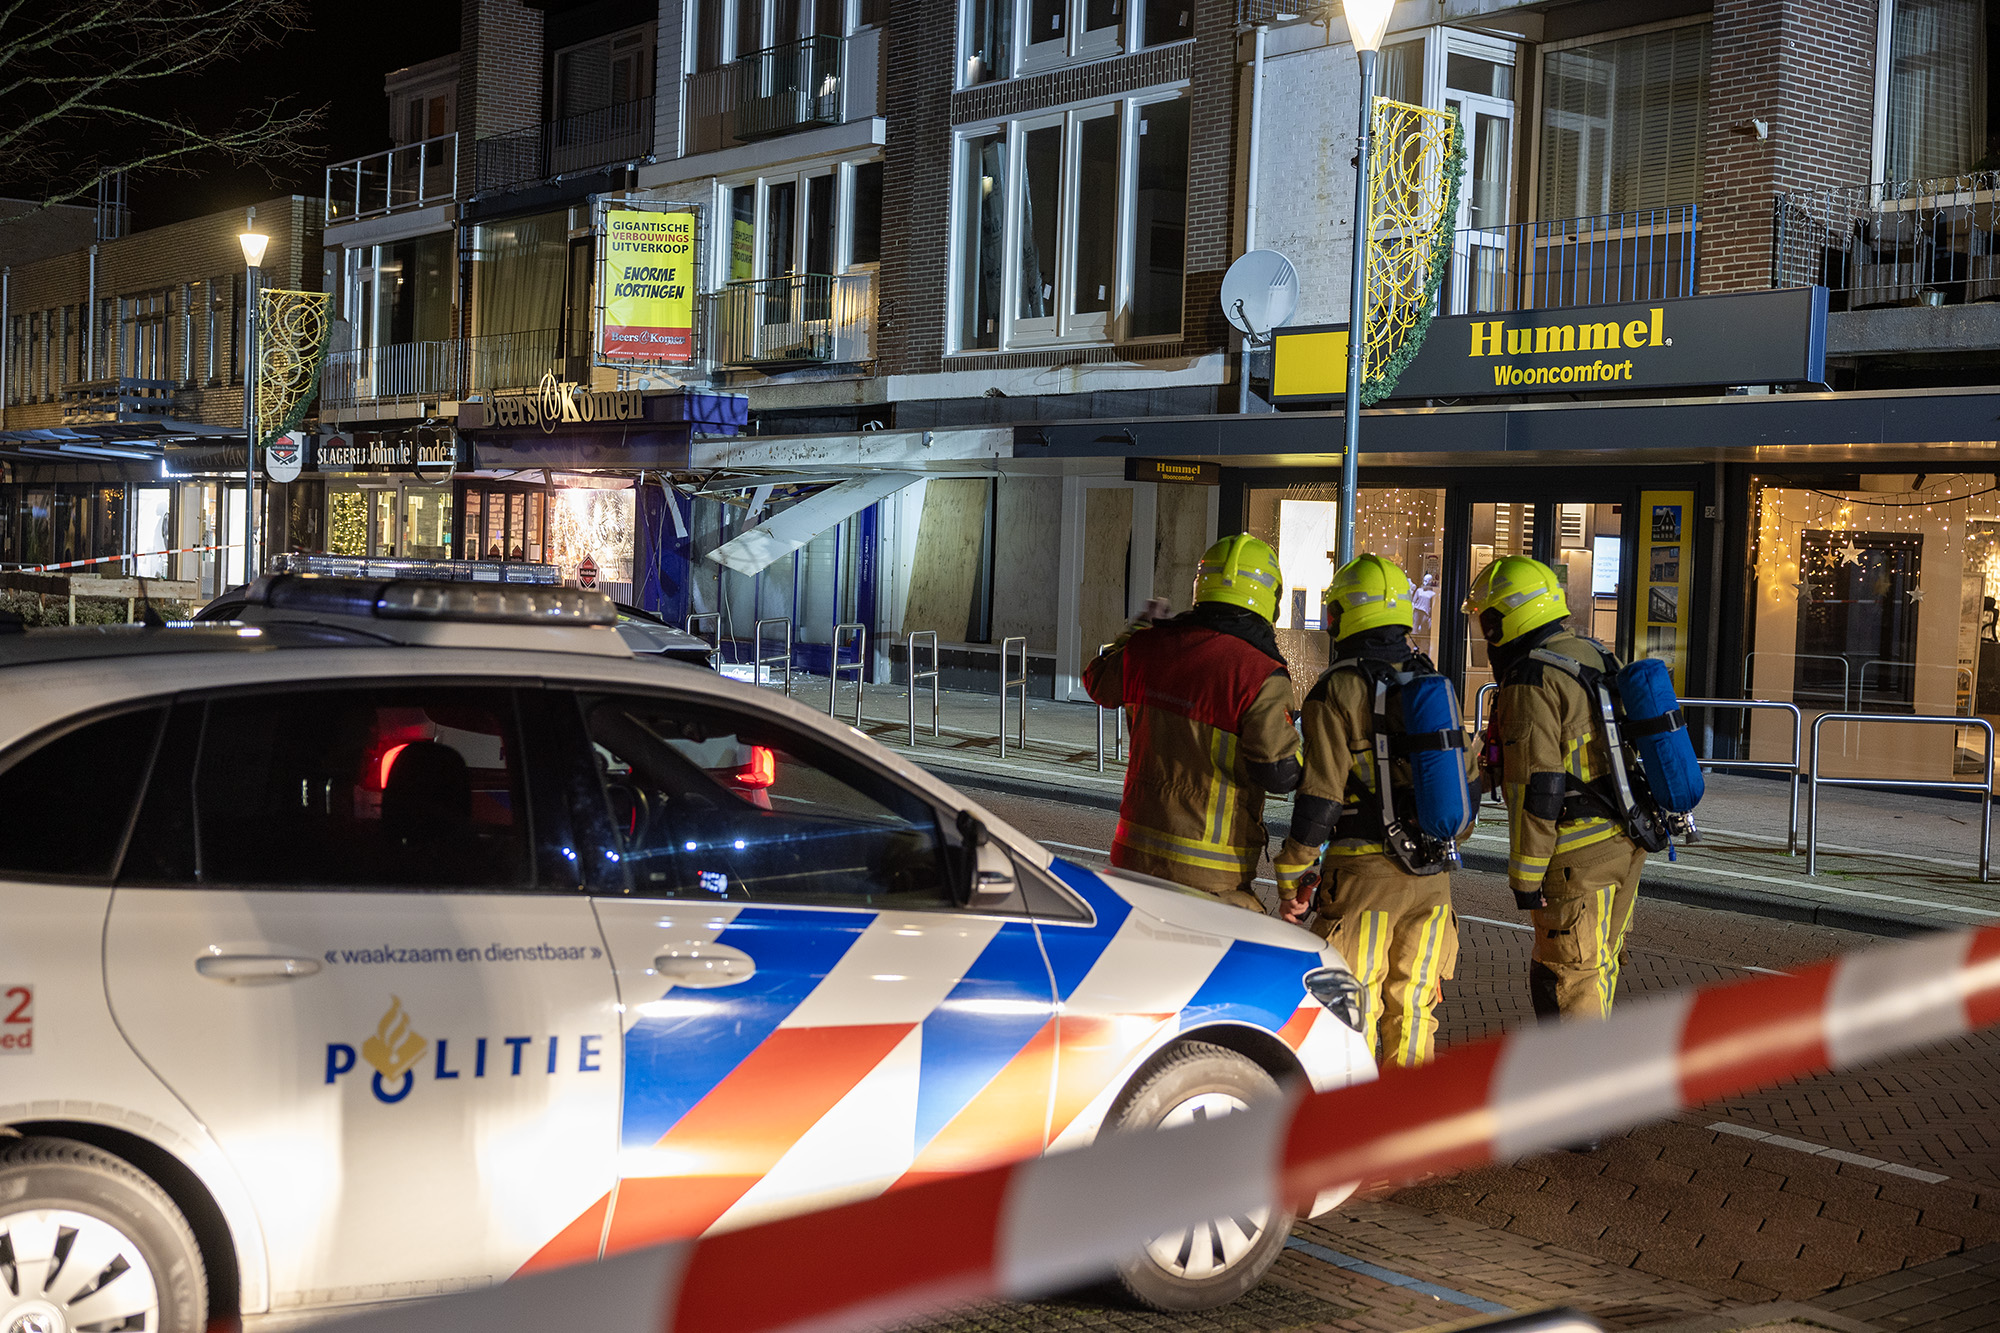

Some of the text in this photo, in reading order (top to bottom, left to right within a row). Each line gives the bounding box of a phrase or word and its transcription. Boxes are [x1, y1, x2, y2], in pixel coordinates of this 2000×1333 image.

[613, 221, 689, 233] GIGANTISCHE
[612, 231, 689, 243] VERBOUWINGS
[612, 242, 689, 254] UITVERKOOP
[623, 266, 676, 282] ENORME
[614, 283, 685, 299] KORTINGEN
[611, 332, 639, 342] Beers
[650, 333, 686, 344] Komen
[1468, 308, 1664, 357] Hummel
[1494, 359, 1633, 386] Wooncomfort
[481, 388, 538, 426] Beers
[559, 381, 644, 423] Komen
[317, 447, 366, 465] SLAGERIJ
[367, 439, 397, 465] John
[1156, 462, 1201, 474] Hummel
[1162, 473, 1195, 481] Wooncomfort
[342, 944, 450, 964] waakzaam
[456, 948, 482, 963] en
[485, 943, 586, 963] dienstbaar
[0, 1027, 32, 1049] ed
[324, 1034, 603, 1104] POLITIE
